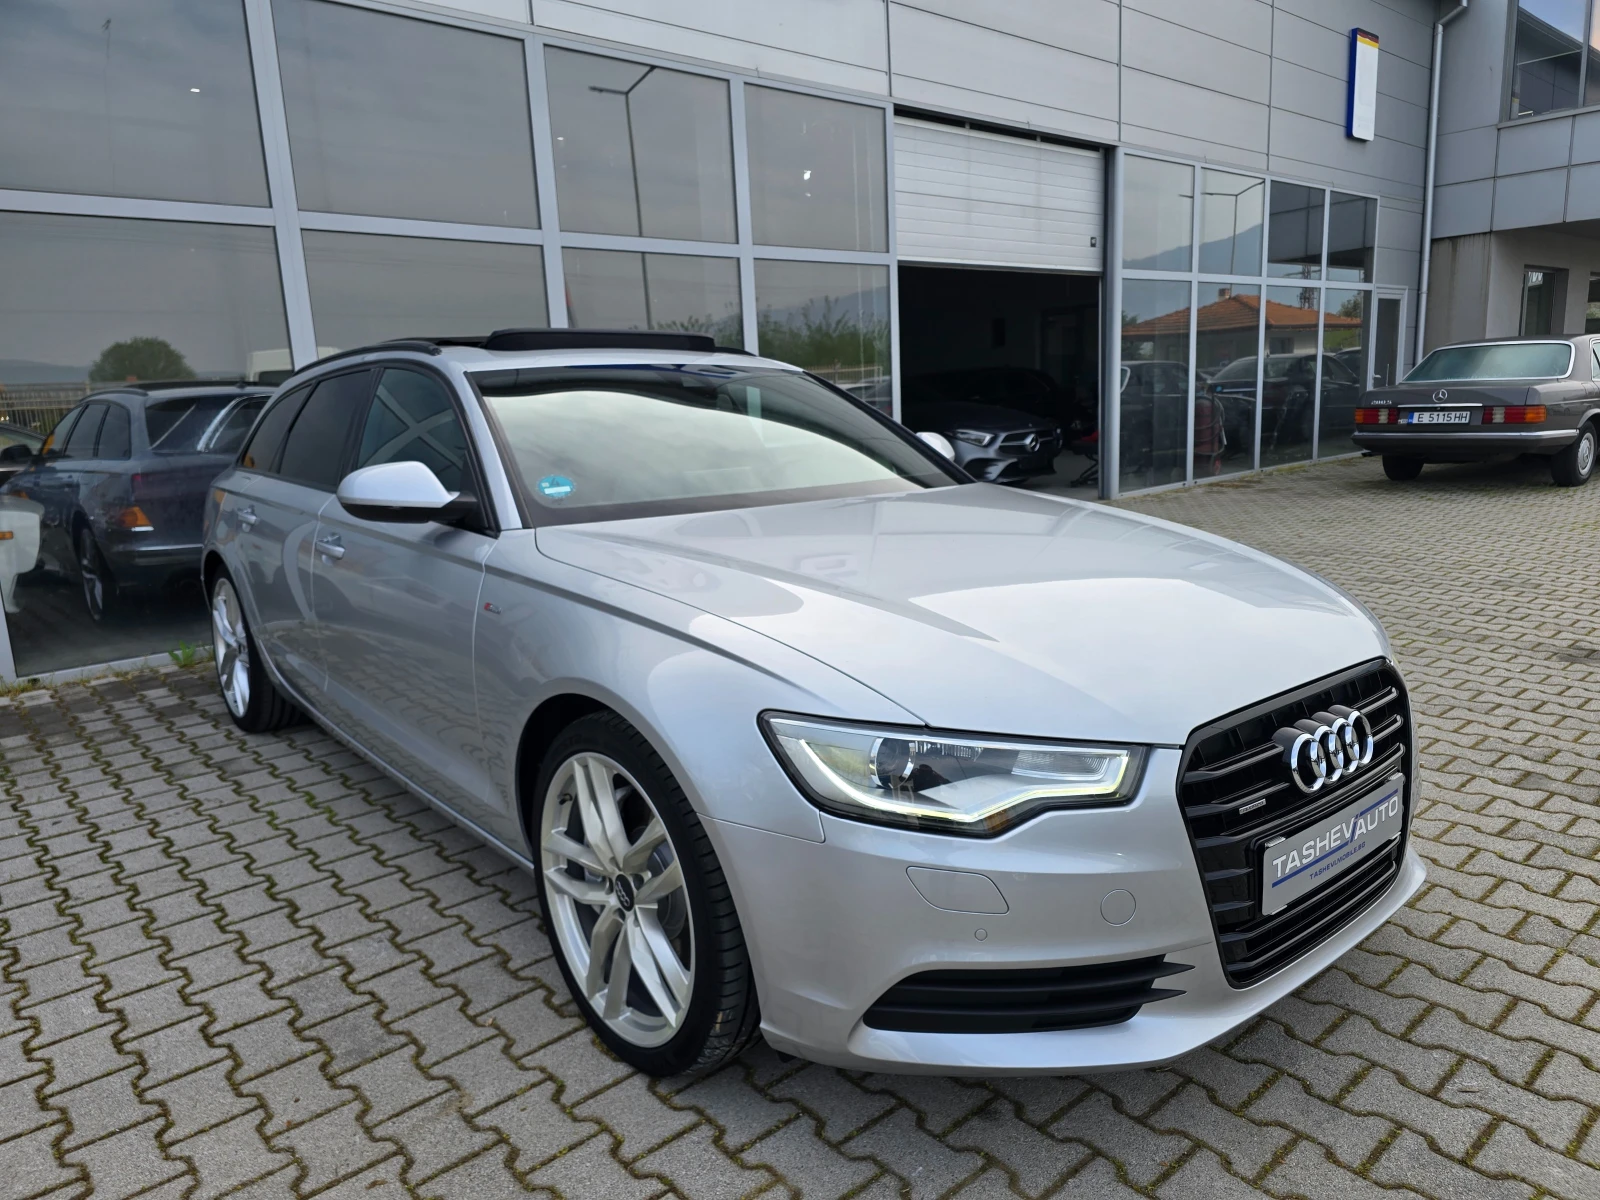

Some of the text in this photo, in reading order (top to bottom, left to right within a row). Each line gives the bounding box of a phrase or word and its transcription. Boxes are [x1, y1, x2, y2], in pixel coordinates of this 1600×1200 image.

[1417, 413, 1424, 422] E
[1428, 412, 1452, 422] 5115
[1454, 412, 1468, 422] HH
